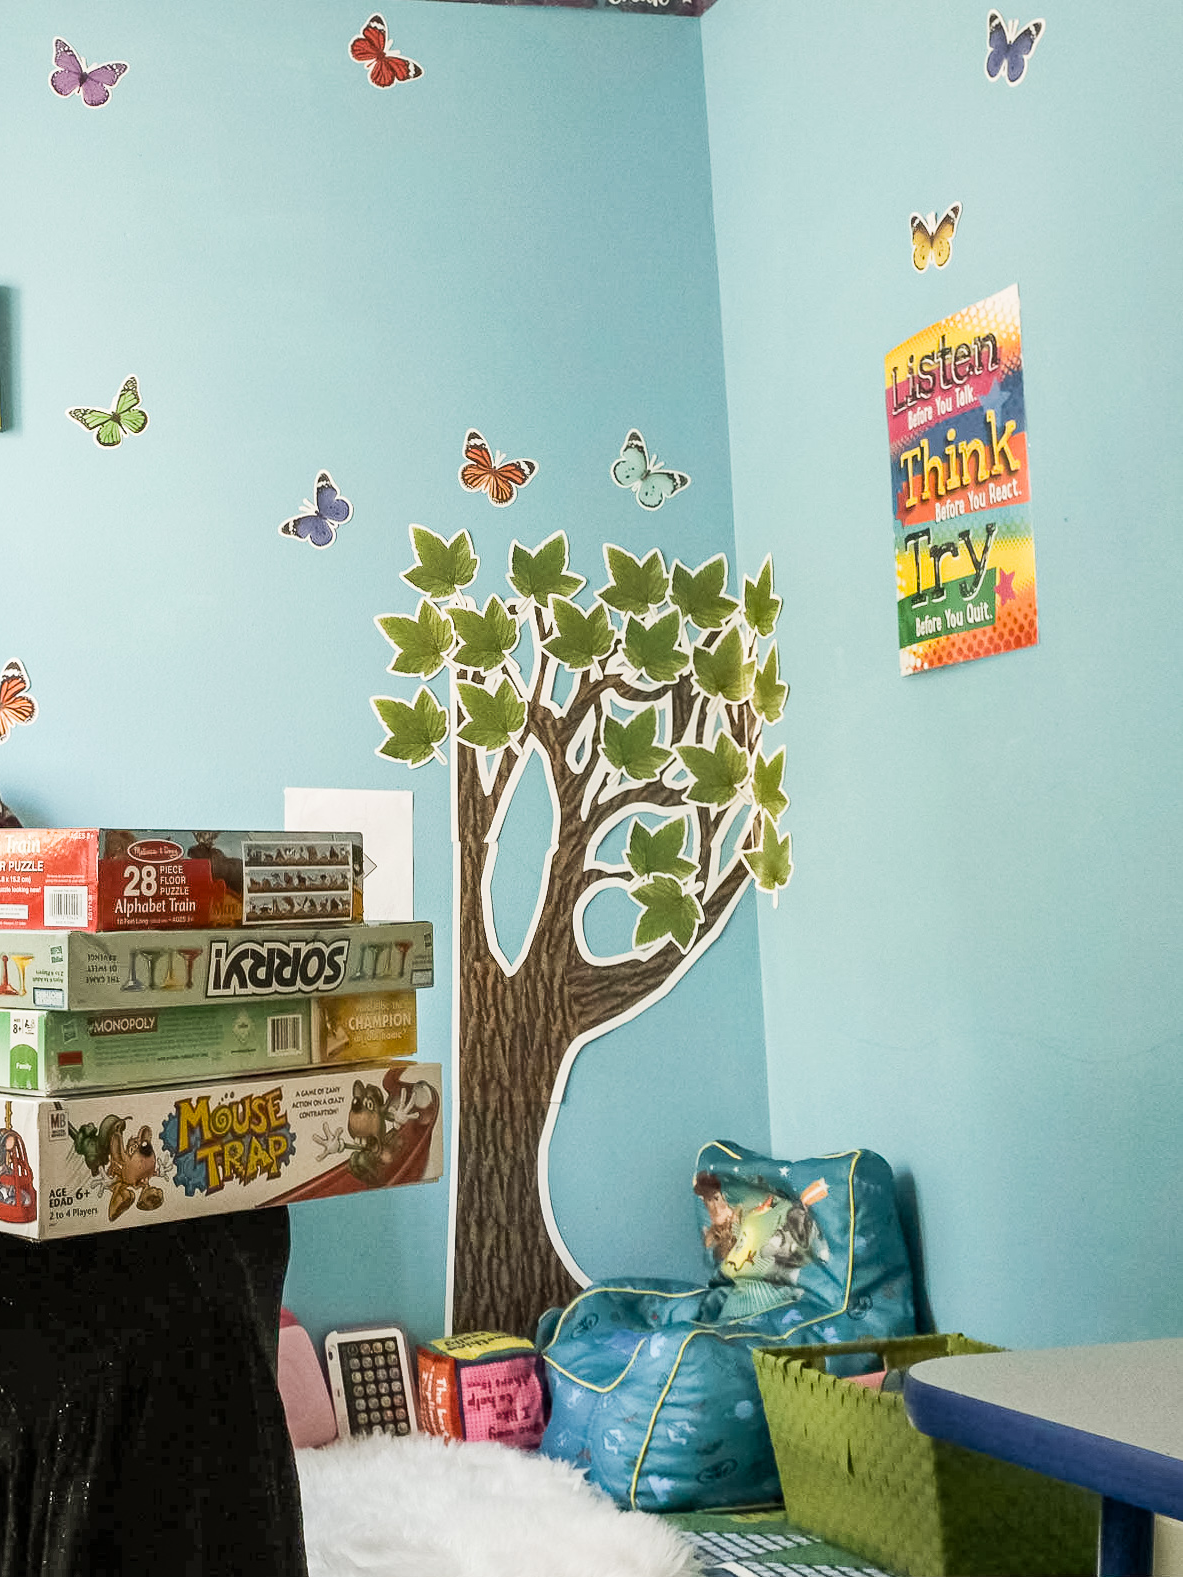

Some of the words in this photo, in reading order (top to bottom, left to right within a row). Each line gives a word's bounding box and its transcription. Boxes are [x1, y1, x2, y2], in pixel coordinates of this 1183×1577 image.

[891, 332, 1000, 415] Listen
[907, 406, 933, 430] Before
[935, 395, 952, 416] You
[955, 386, 977, 408] Talk.
[900, 409, 1021, 508] Think
[935, 499, 965, 523] Before
[967, 489, 986, 512] You
[988, 478, 1022, 505] React.
[904, 522, 998, 609] Try
[915, 614, 942, 637] Before
[944, 608, 963, 629] You
[966, 601, 993, 624] Quit.
[5, 834, 40, 853] Train
[8, 861, 44, 872] PUZZLE
[160, 865, 183, 874] PIECE
[123, 865, 158, 897] 28
[160, 876, 186, 885] FLOOR
[12, 886, 29, 894] looking
[160, 886, 189, 895] PUZZLE
[114, 898, 166, 917] Alphabet
[169, 898, 196, 912] Train
[209, 942, 347, 994] SORRY!
[13, 1023, 22, 1034] 8+
[94, 1016, 156, 1033] MONOPOLY
[348, 1012, 411, 1031] CHAMPION
[301, 1089, 316, 1097] GAME
[326, 1086, 340, 1094] ZANY
[328, 1096, 344, 1104] CRAZY
[50, 1113, 66, 1129] MB
[176, 1089, 287, 1155] MOUSE
[196, 1136, 287, 1193] TRAP
[49, 1188, 67, 1198] AGE
[75, 1187, 90, 1200] 6+
[49, 1197, 73, 1208] EDAD
[49, 1212, 54, 1220] 2
[56, 1210, 64, 1219] to
[66, 1208, 71, 1218] 4
[73, 1206, 98, 1218] Players
[436, 1377, 447, 1404] The
[499, 1393, 513, 1405] to
[468, 1393, 496, 1411] help
[496, 1409, 517, 1422] like
[522, 1406, 530, 1419] I
